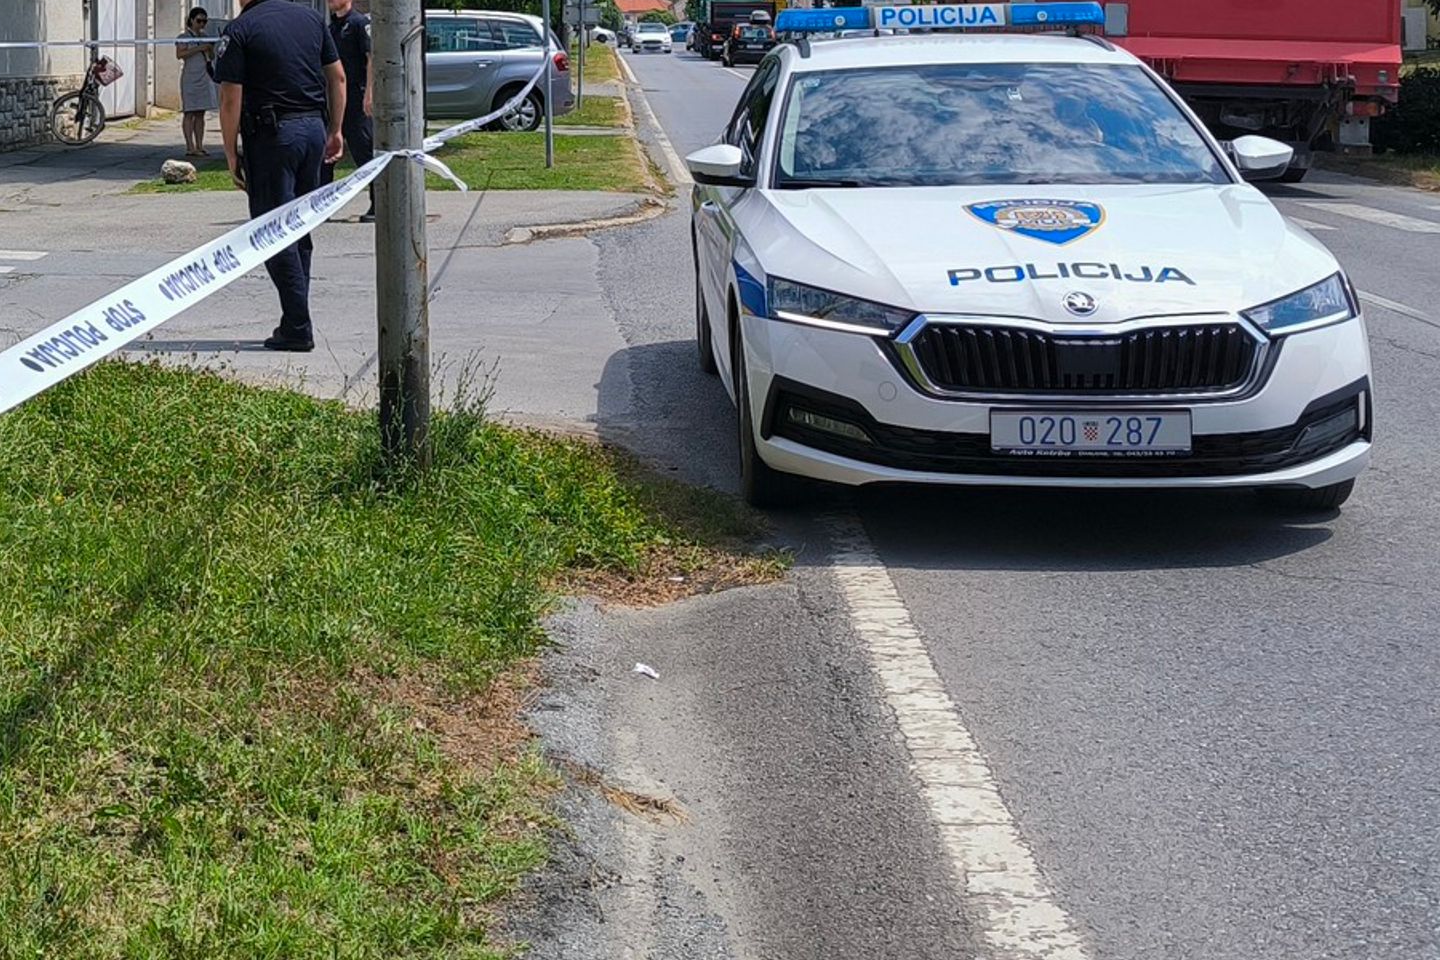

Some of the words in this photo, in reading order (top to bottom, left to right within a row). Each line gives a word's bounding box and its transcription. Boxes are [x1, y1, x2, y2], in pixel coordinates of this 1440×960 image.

[881, 6, 997, 25] POLICIJA
[212, 244, 241, 274] STOP
[947, 262, 1197, 286] POLICIJA
[162, 258, 216, 299] POLICIJA
[102, 299, 146, 332] STOP
[25, 320, 108, 368] POLICIJA
[1019, 416, 1076, 445] 020
[1106, 417, 1162, 446] 287
